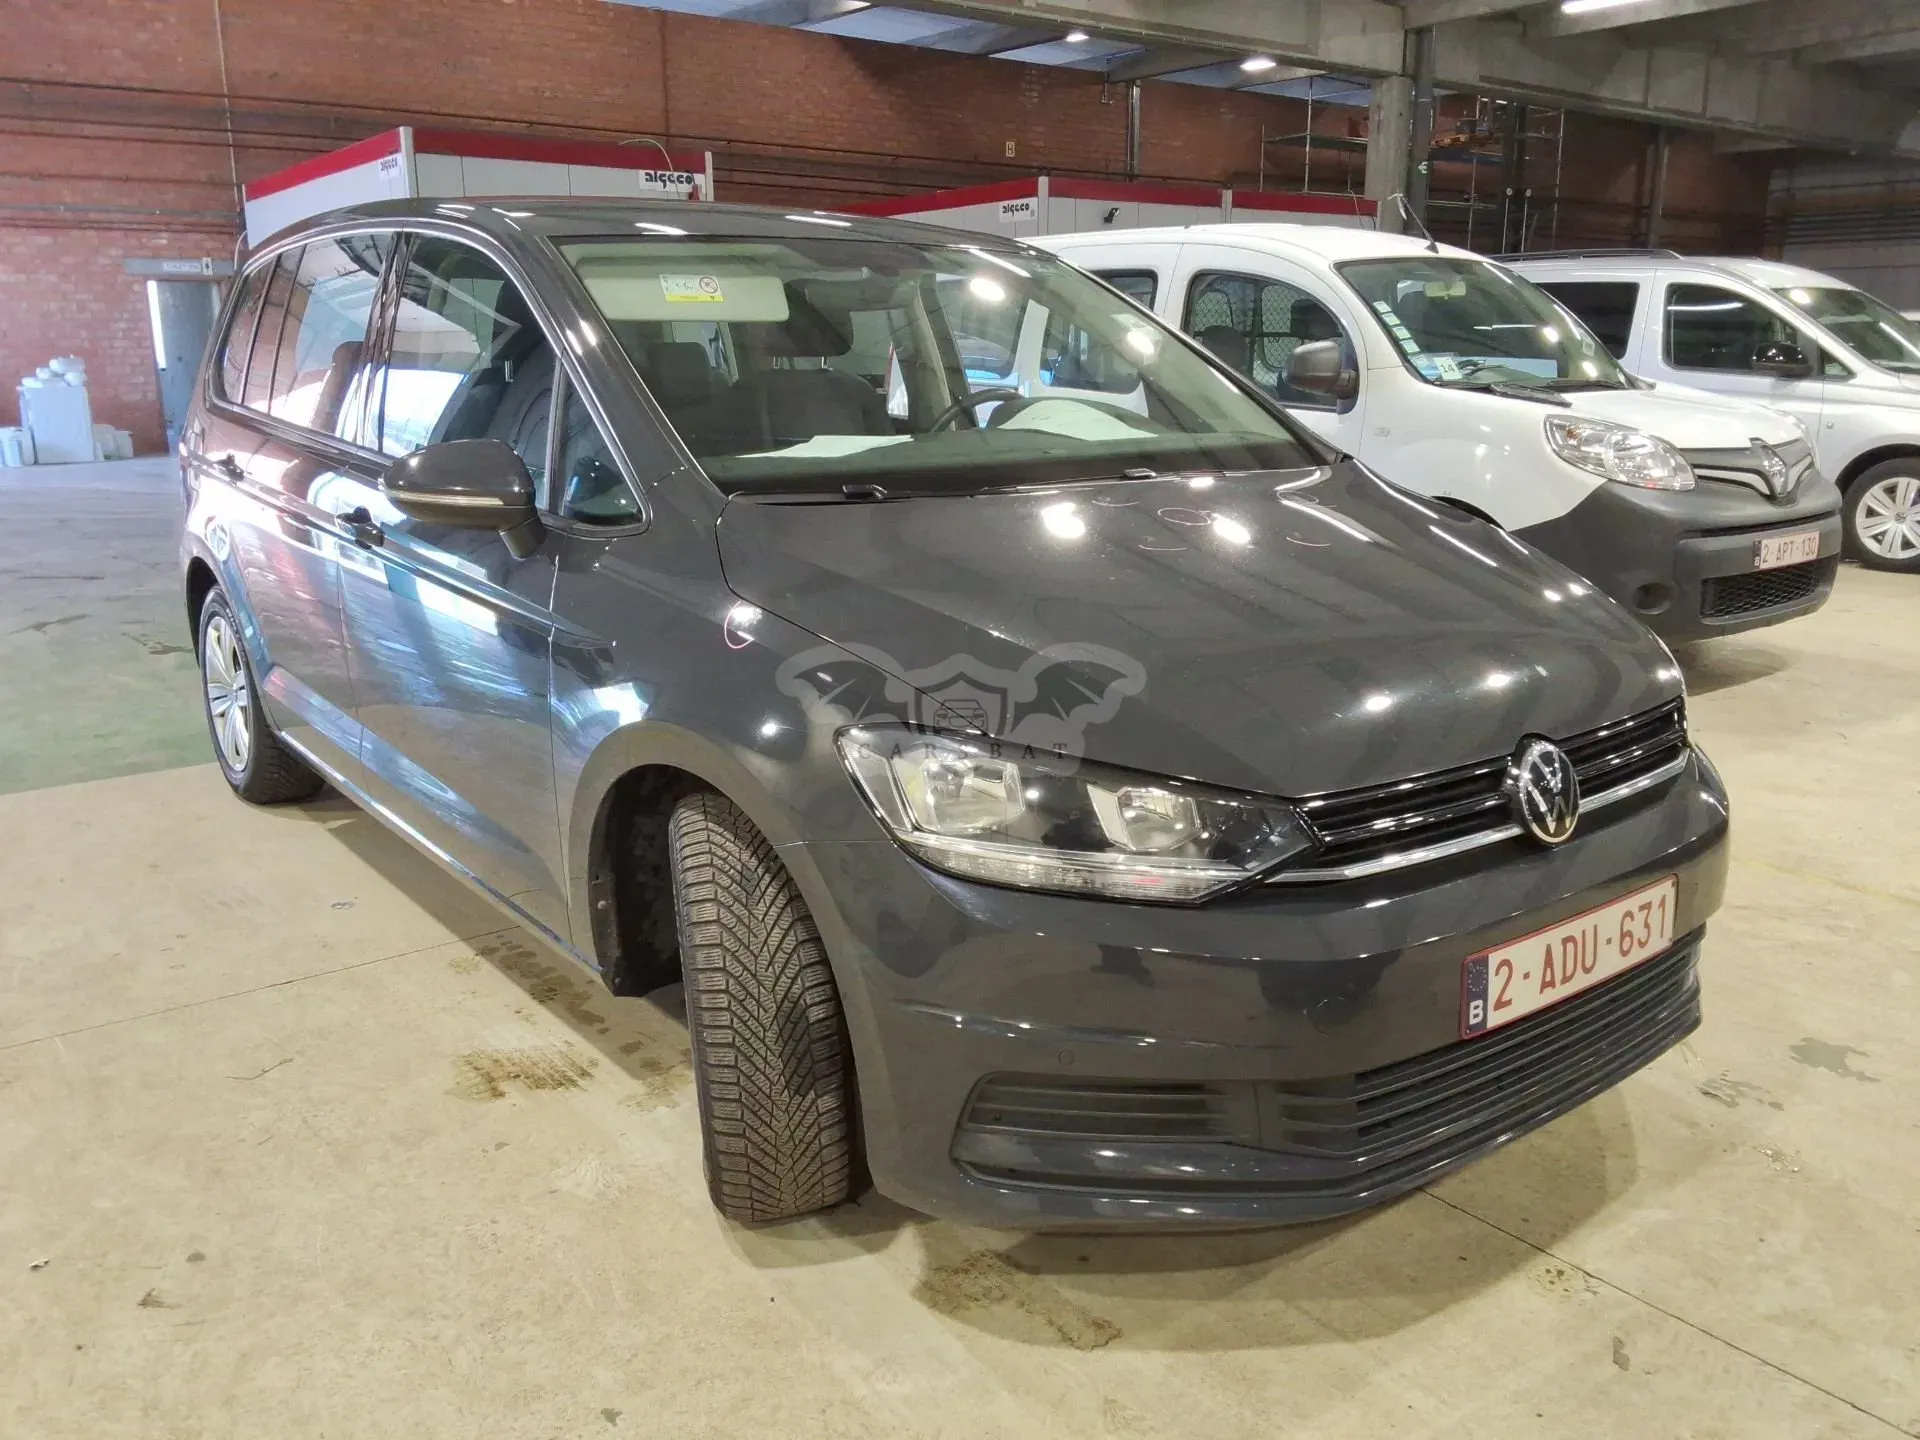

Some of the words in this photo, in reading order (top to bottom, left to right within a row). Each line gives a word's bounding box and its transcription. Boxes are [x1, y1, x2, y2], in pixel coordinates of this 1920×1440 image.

[1441, 363, 1456, 374] 14
[1493, 894, 1668, 1013] 2-ADU-631
[1468, 999, 1484, 1025] B
